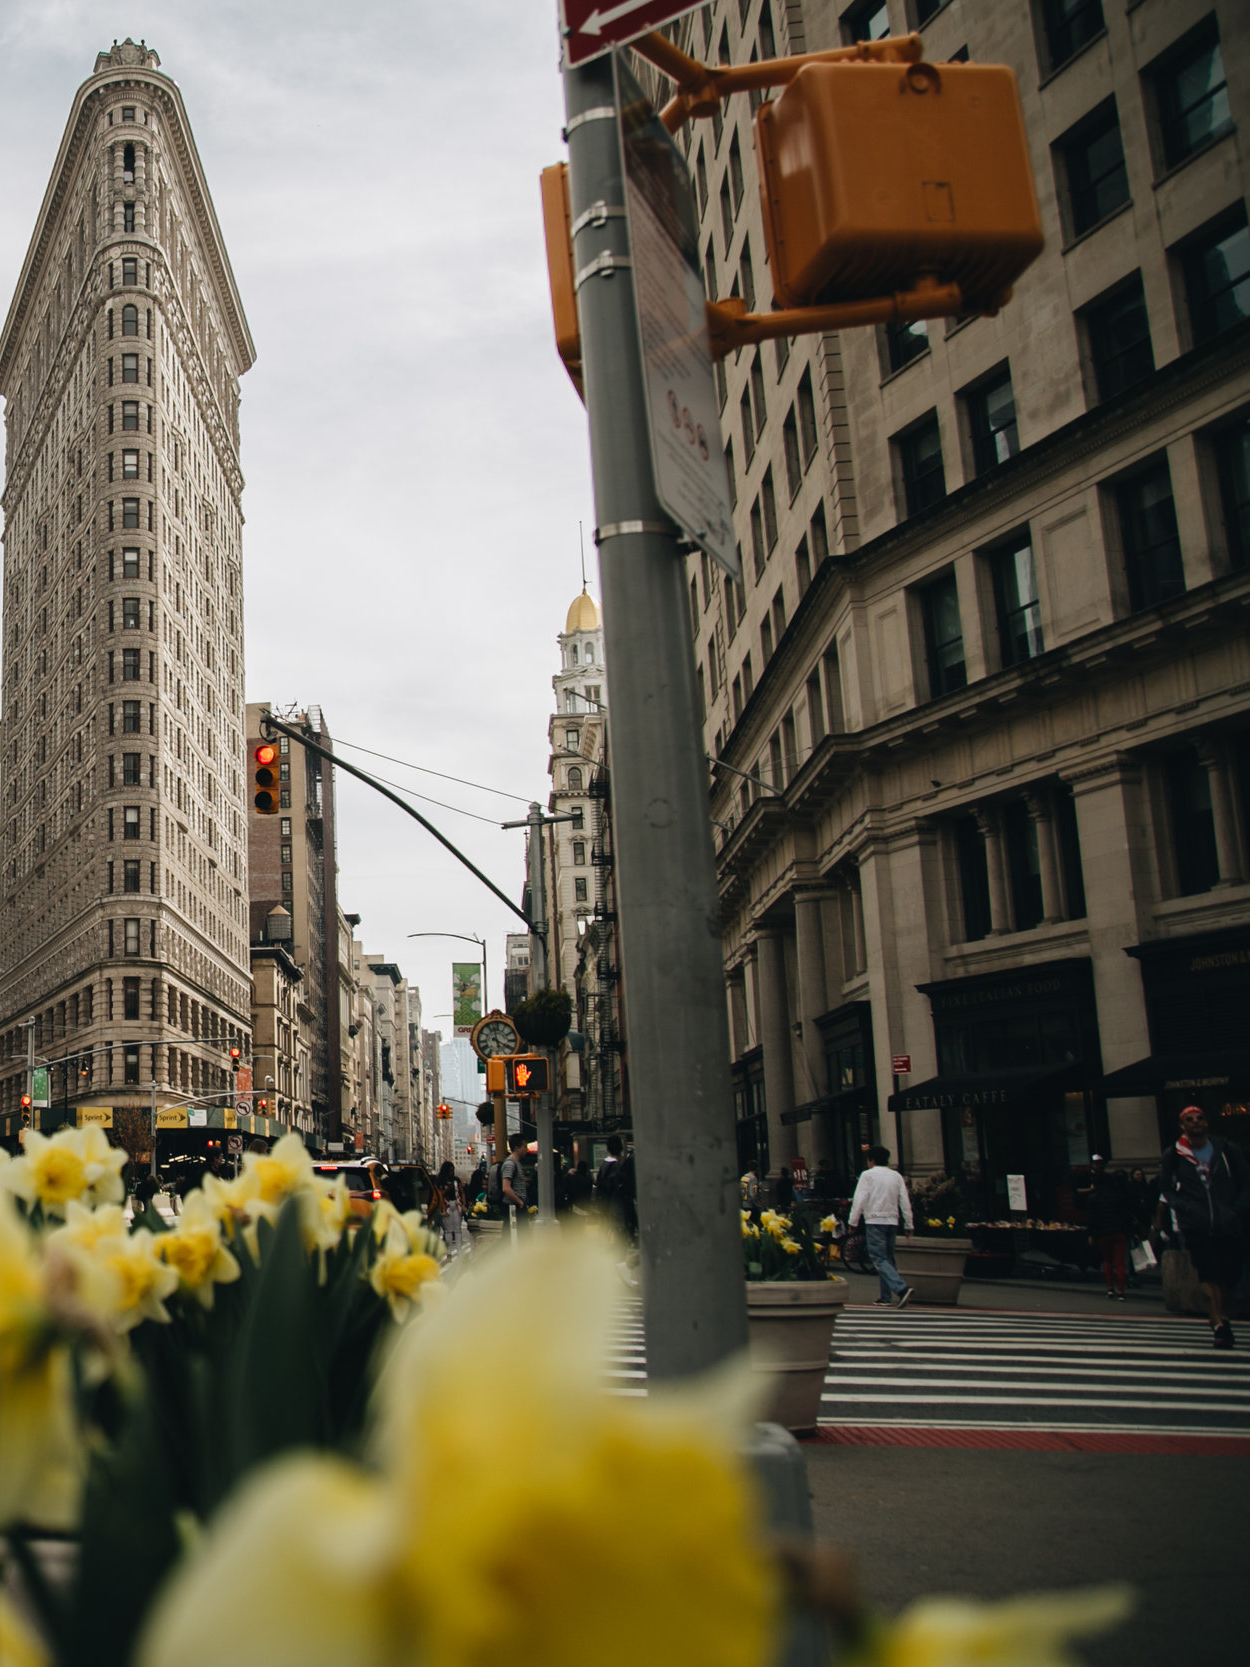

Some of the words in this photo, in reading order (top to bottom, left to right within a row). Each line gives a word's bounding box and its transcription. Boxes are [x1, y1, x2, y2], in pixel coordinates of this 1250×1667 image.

[1027, 978, 1062, 995] FOOD
[905, 1092, 956, 1109] EATALY
[84, 1113, 103, 1121] Sprint
[158, 1114, 178, 1122] Sprint
